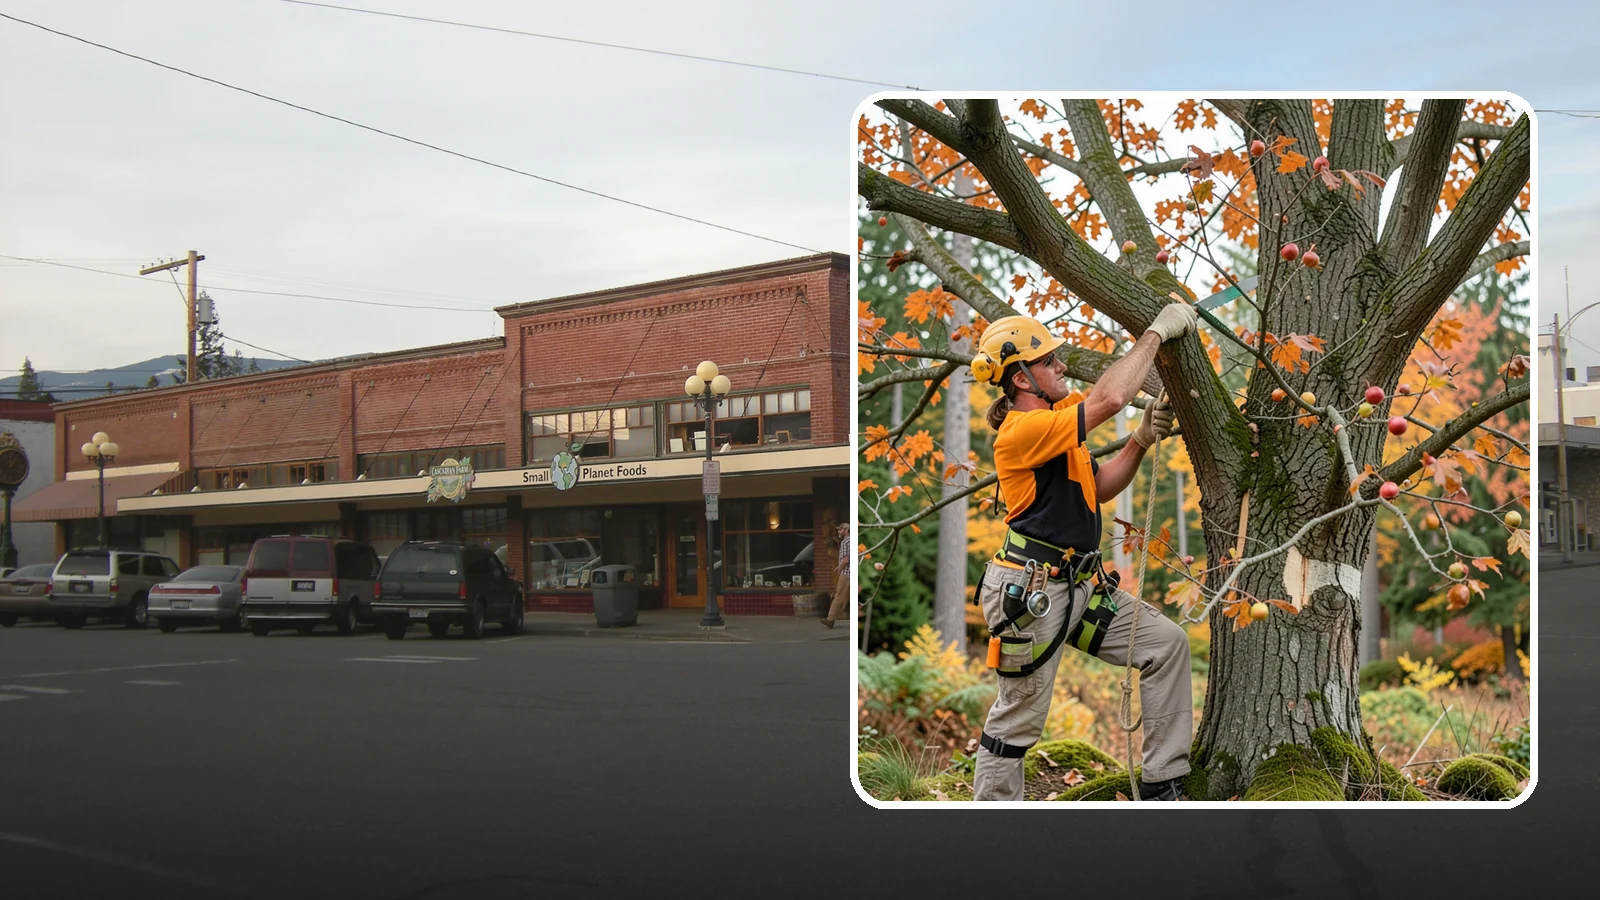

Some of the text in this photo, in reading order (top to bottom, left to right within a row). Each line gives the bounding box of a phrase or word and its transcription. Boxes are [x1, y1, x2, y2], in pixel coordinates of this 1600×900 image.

[523, 464, 647, 483] Small Planet Foods
